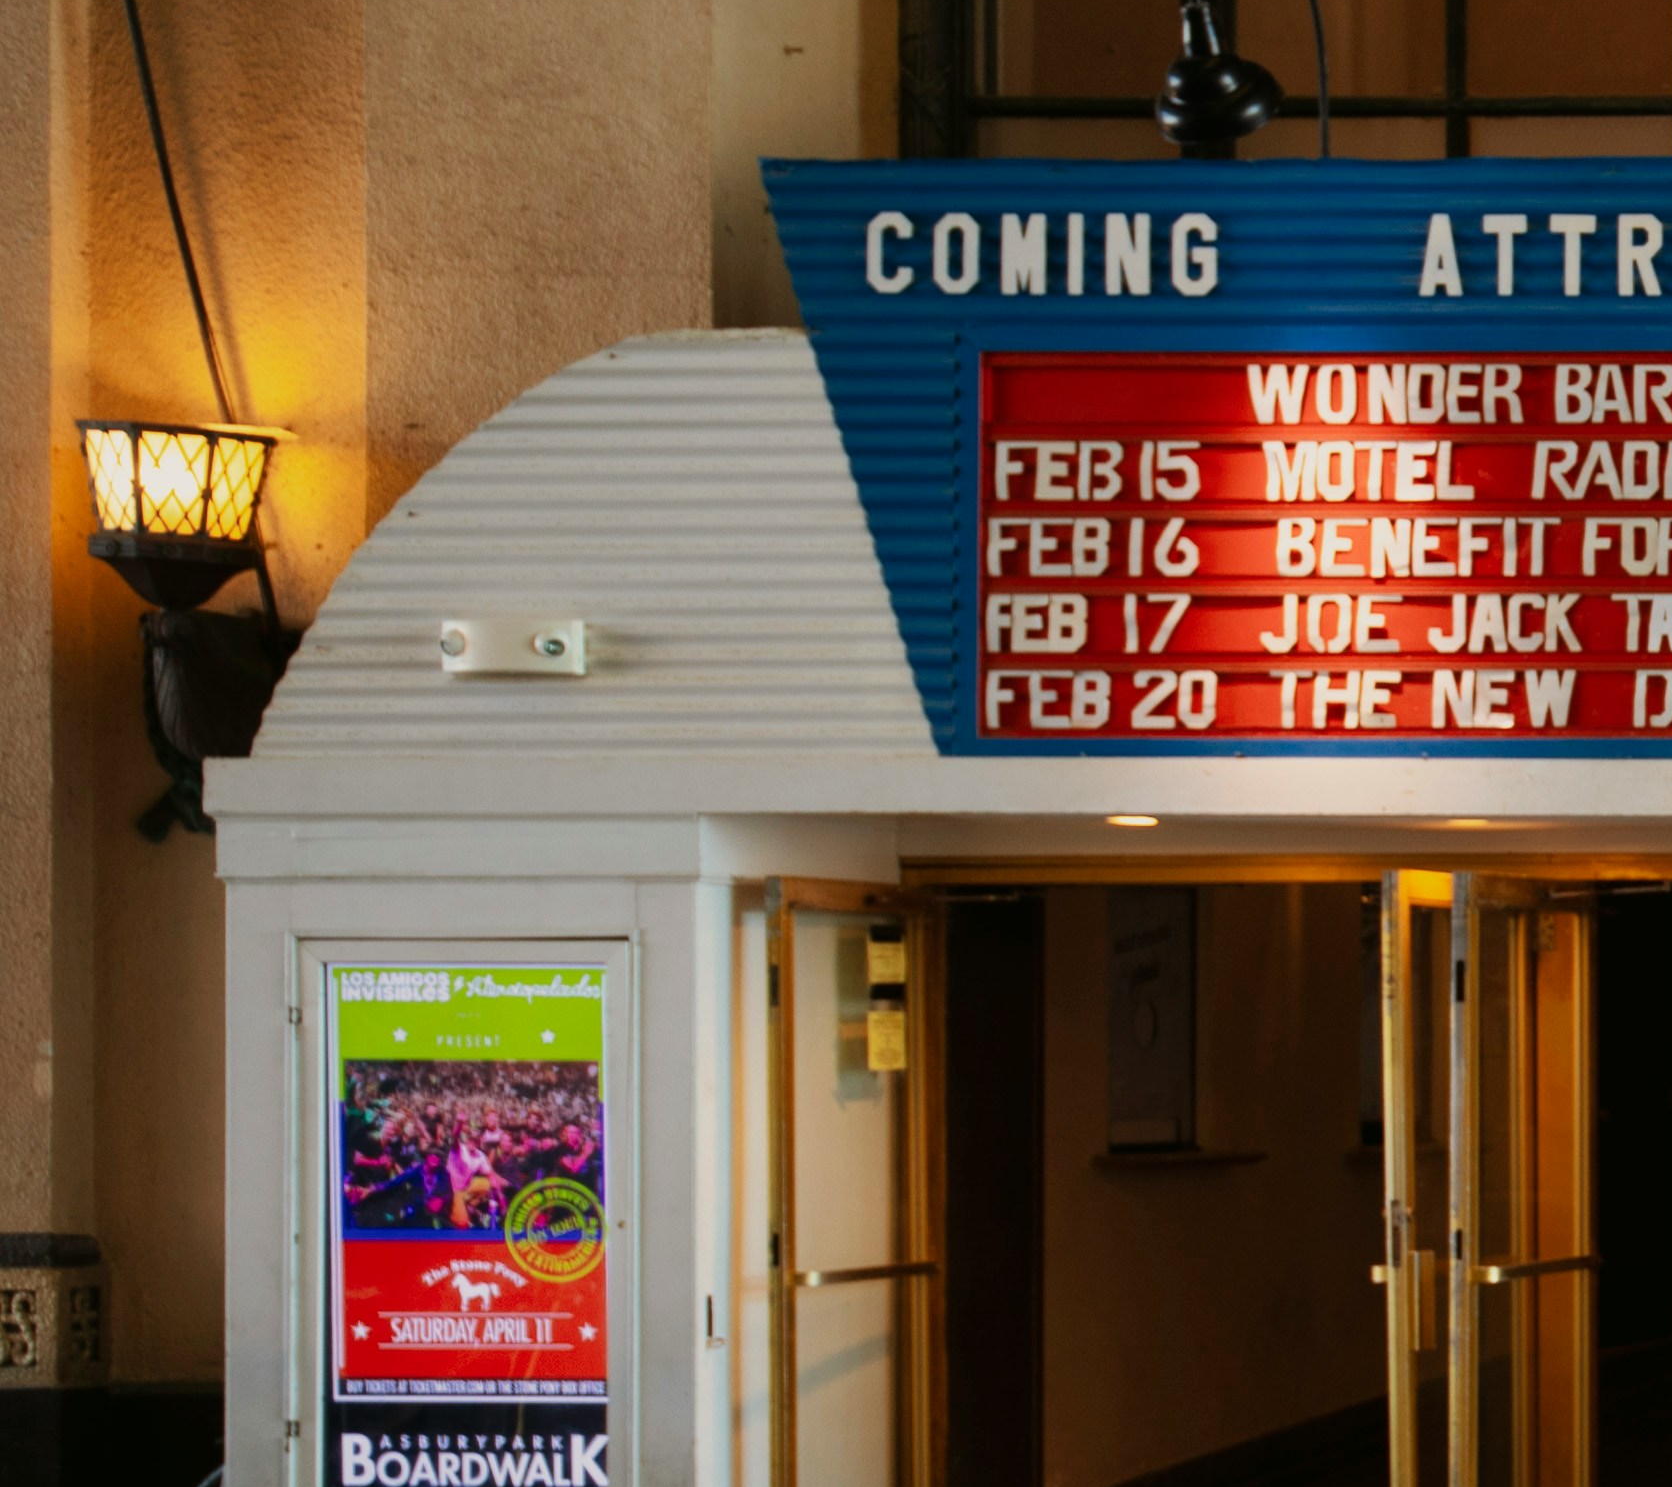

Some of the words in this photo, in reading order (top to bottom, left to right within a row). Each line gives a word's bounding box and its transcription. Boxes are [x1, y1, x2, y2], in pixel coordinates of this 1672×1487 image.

[863, 210, 1220, 297] COMING
[1246, 364, 1524, 425] WONDER
[995, 440, 1124, 501] FEB
[1139, 440, 1201, 501] 15
[1261, 440, 1476, 502] MOTEL
[987, 517, 1112, 578] FEB
[1127, 517, 1200, 578] 16
[1275, 517, 1562, 578] BENEFIT
[986, 593, 1089, 654] FEB
[1122, 593, 1192, 654] 17
[1259, 593, 1404, 654] JOE
[1427, 593, 1583, 654] JACK
[986, 669, 1112, 729] FEB
[1131, 669, 1218, 729] 20
[1269, 669, 1402, 729] THE
[1431, 669, 1577, 729] NEW
[341, 971, 375, 987] LOS
[377, 971, 450, 987] AMIGOS
[390, 1316, 480, 1348] SATURDAY,
[482, 1318, 533, 1344] APRIL
[534, 1318, 553, 1344] 11
[341, 1433, 609, 1487] BOARDWALK
